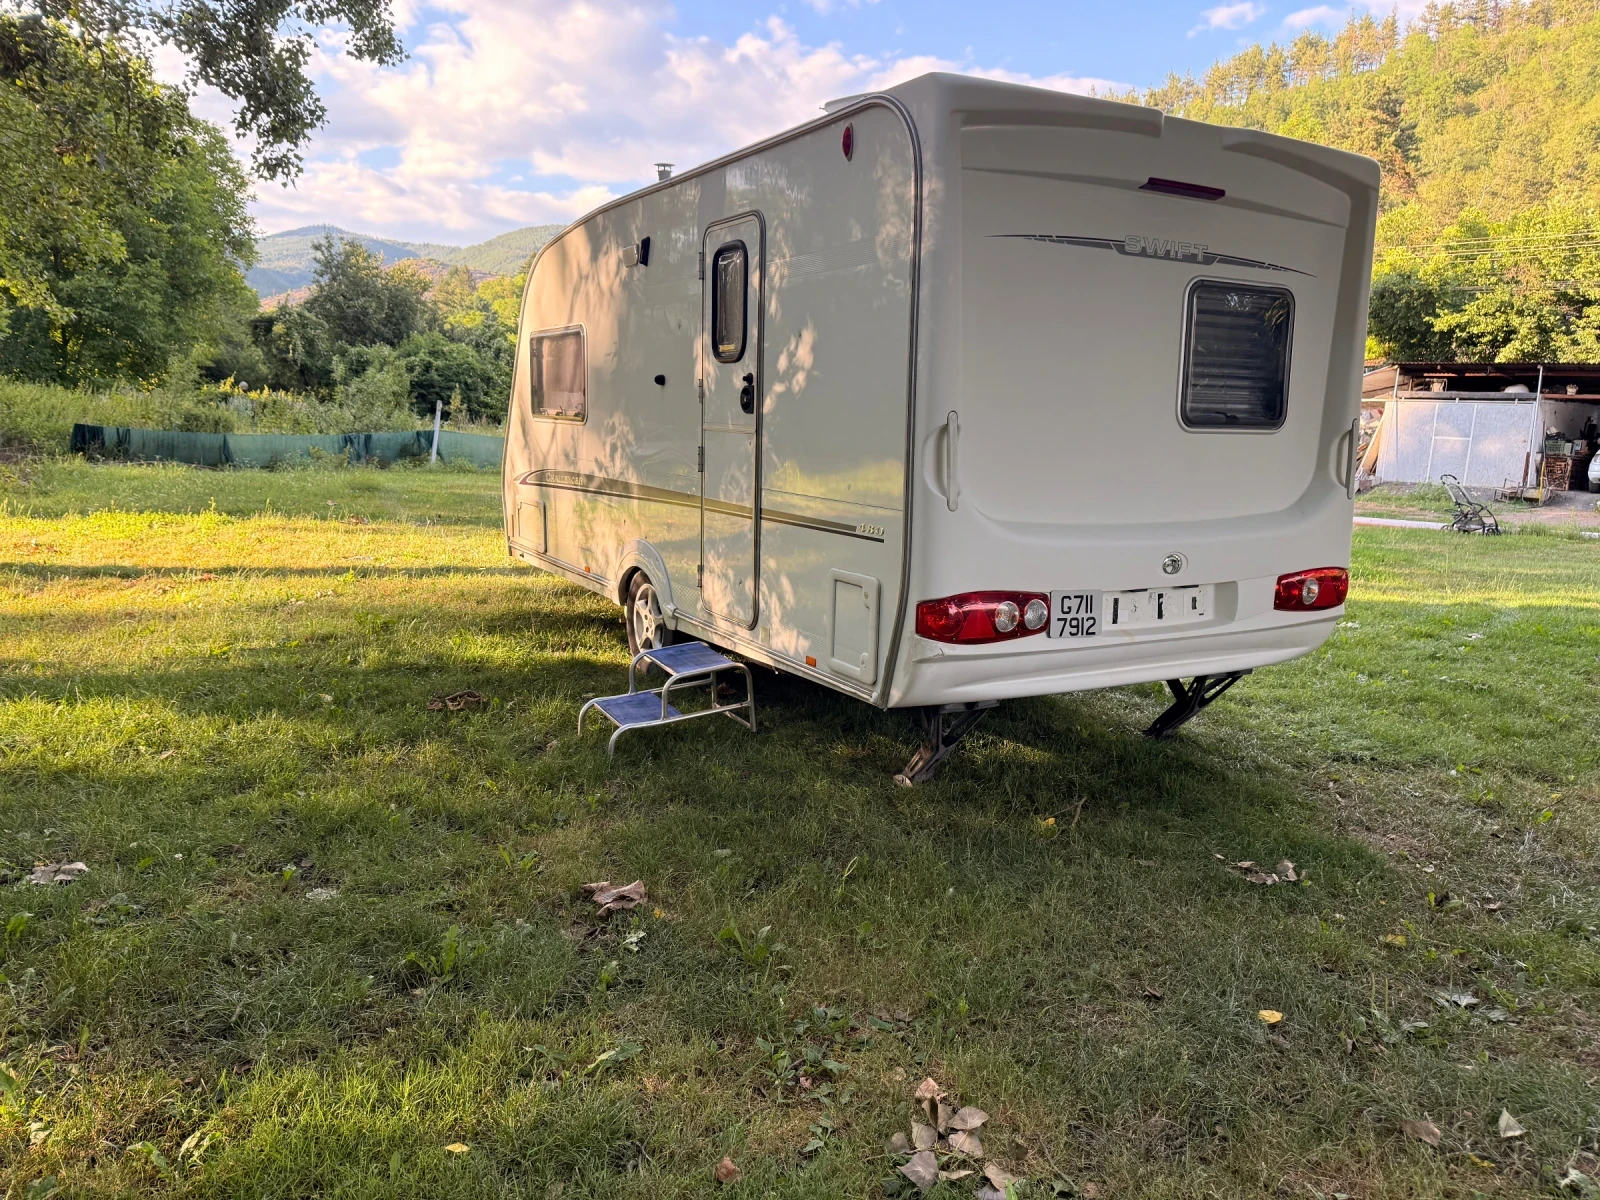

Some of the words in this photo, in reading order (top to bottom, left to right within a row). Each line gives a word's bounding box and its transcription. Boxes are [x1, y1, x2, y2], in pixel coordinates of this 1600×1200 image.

[1124, 235, 1208, 261] SWIFT
[858, 523, 885, 537] 480
[1060, 594, 1093, 615] G711
[1056, 616, 1096, 637] 7912
